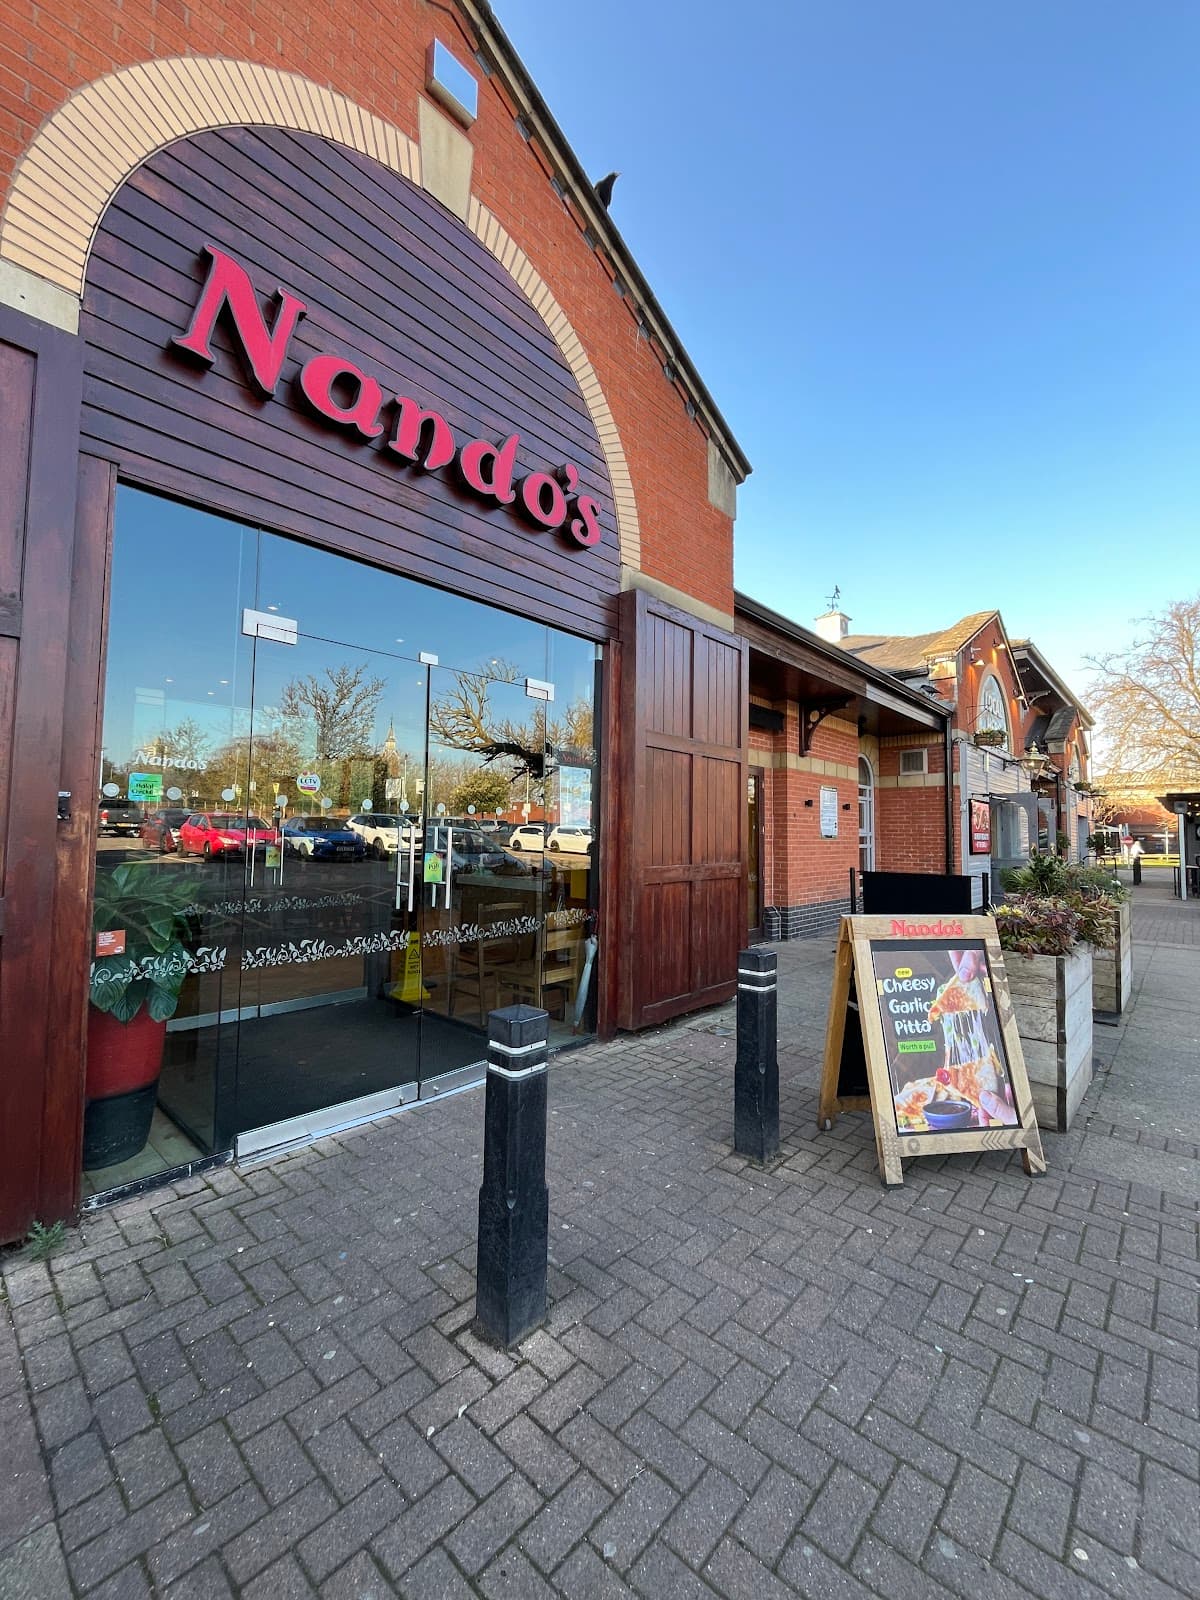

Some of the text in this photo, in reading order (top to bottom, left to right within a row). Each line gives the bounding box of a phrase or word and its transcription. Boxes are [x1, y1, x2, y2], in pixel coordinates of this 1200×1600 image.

[170, 243, 601, 548] Nando's
[133, 750, 208, 769] Nando's
[891, 919, 964, 937] Nando's
[883, 977, 936, 994] Cheesy
[888, 998, 930, 1014] Garlic
[894, 1020, 932, 1035] Pitta
[924, 1042, 934, 1050] pull
